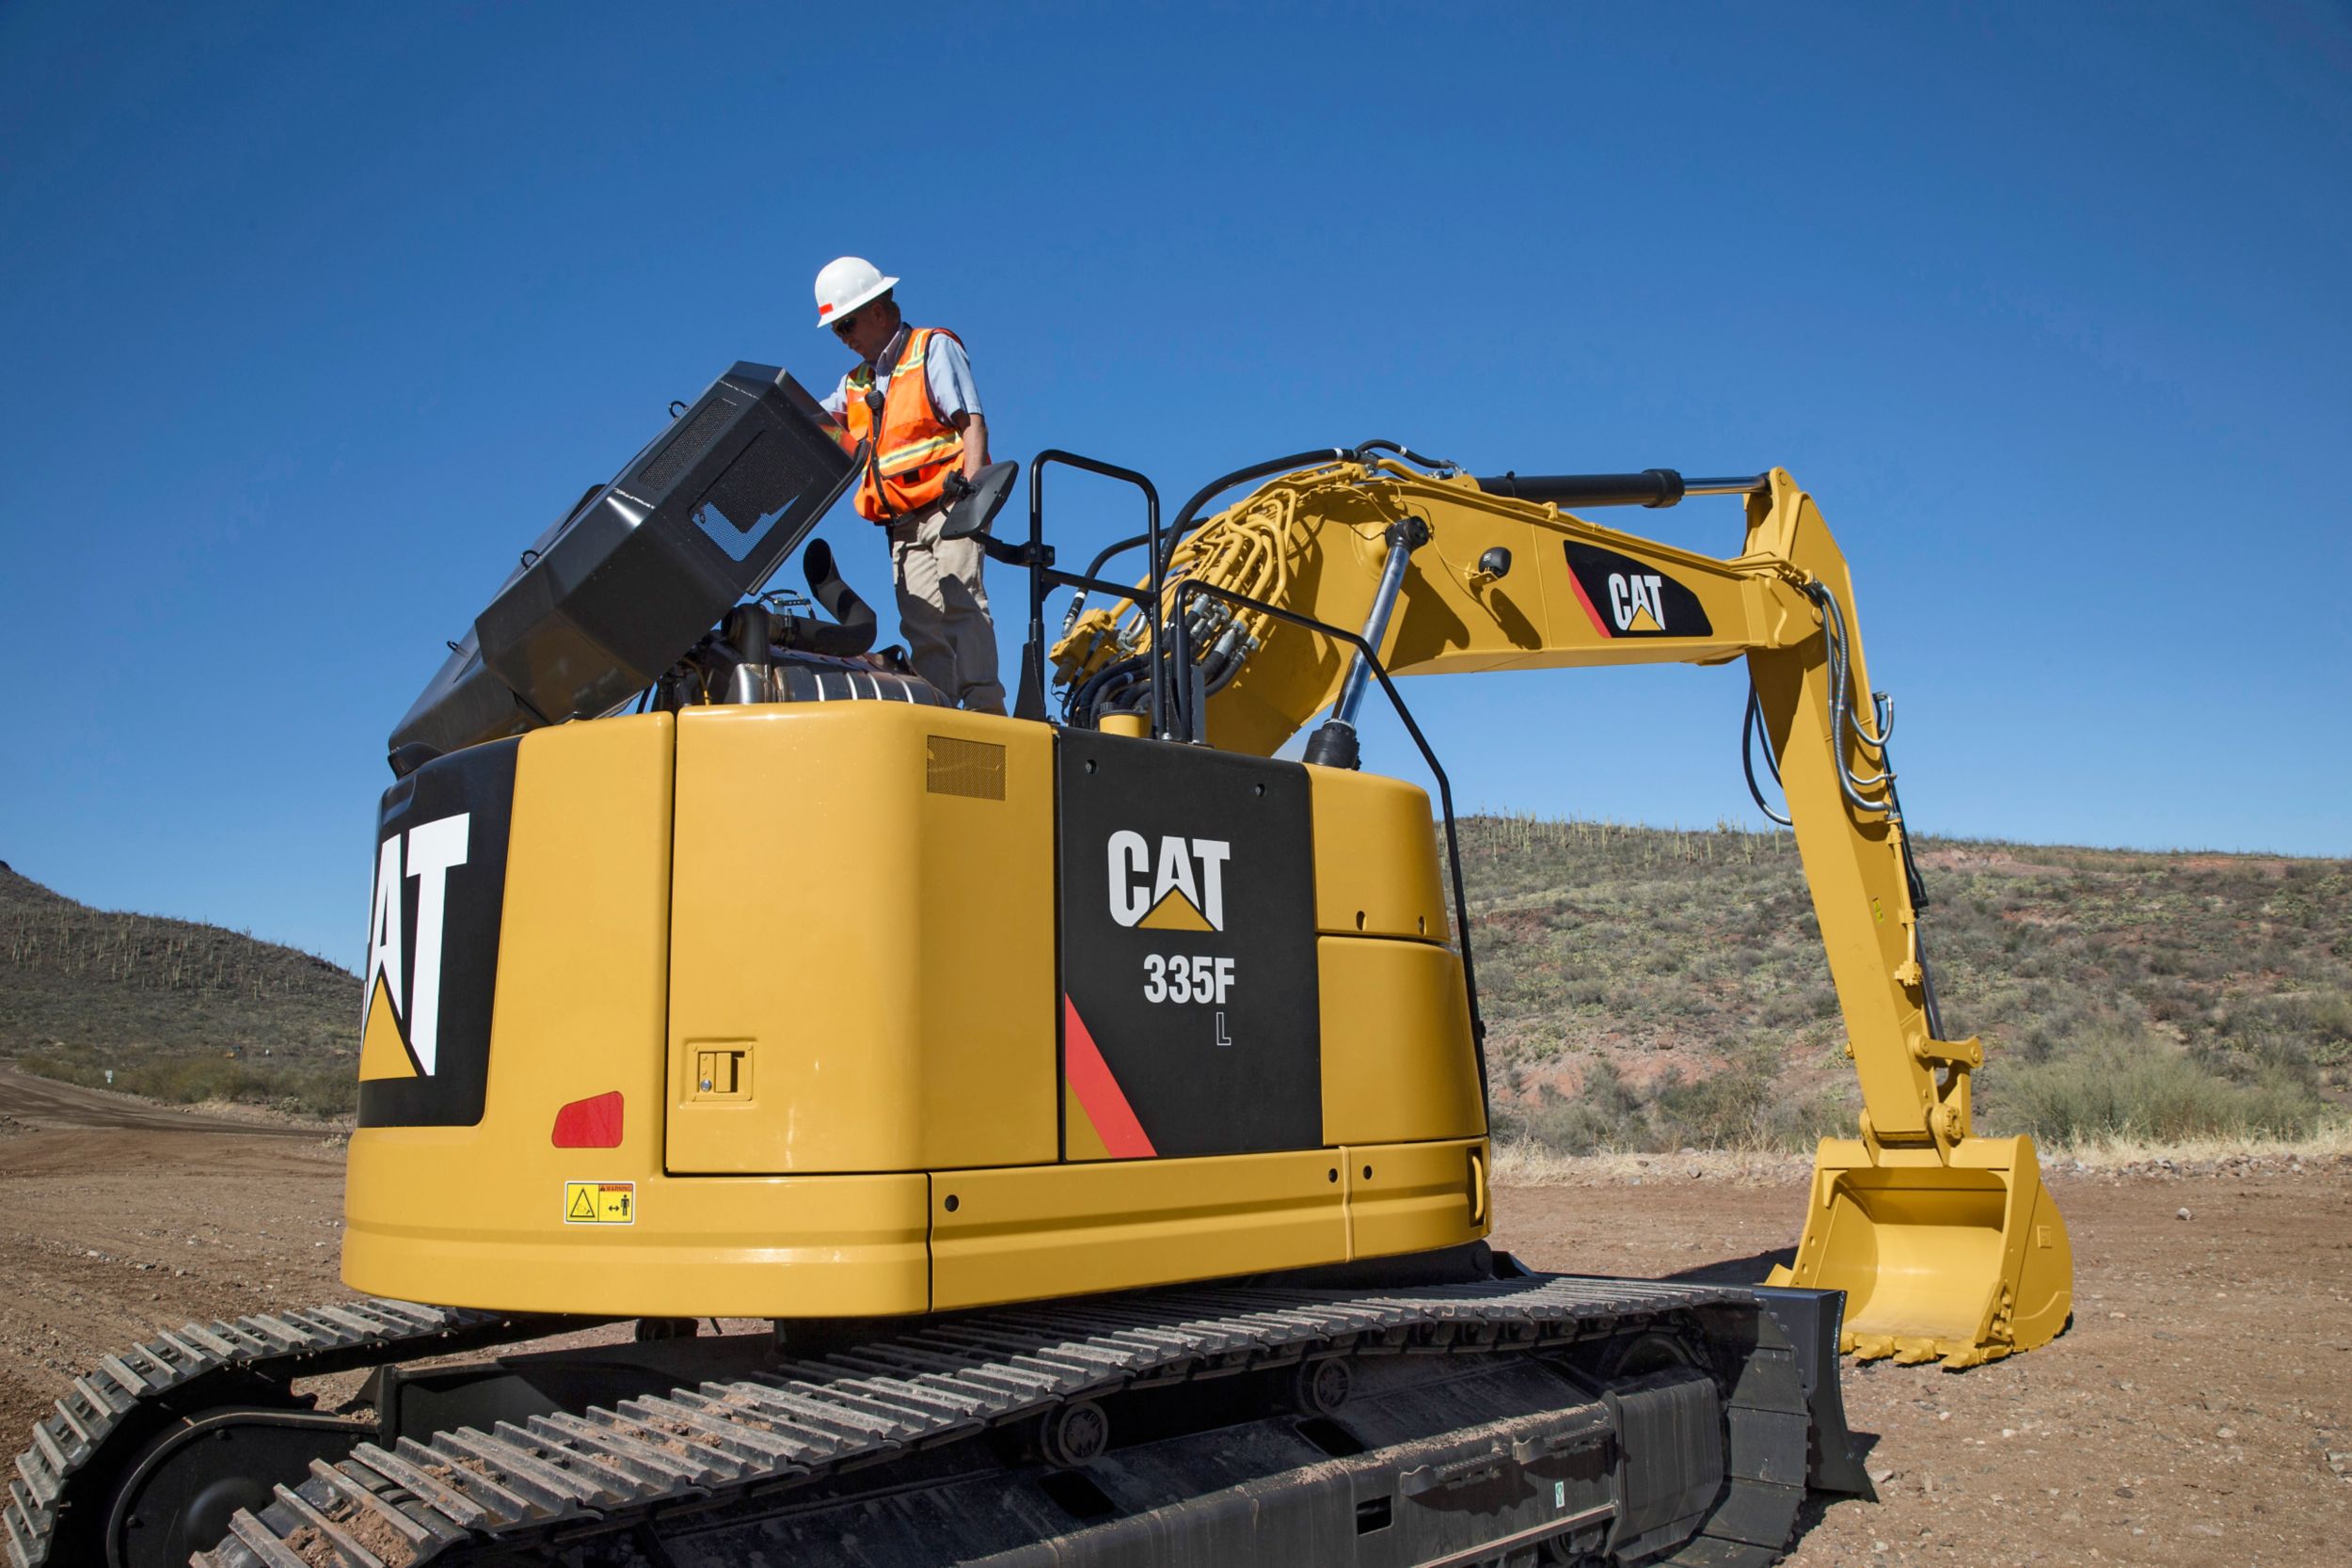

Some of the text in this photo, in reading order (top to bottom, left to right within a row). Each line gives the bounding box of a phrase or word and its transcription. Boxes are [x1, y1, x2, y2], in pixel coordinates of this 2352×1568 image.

[1608, 573, 1666, 631] CAT
[1107, 830, 1231, 932] CAT
[361, 812, 470, 1077] AT
[1143, 954, 1235, 1005] 335F
[1216, 1011, 1232, 1046] L
